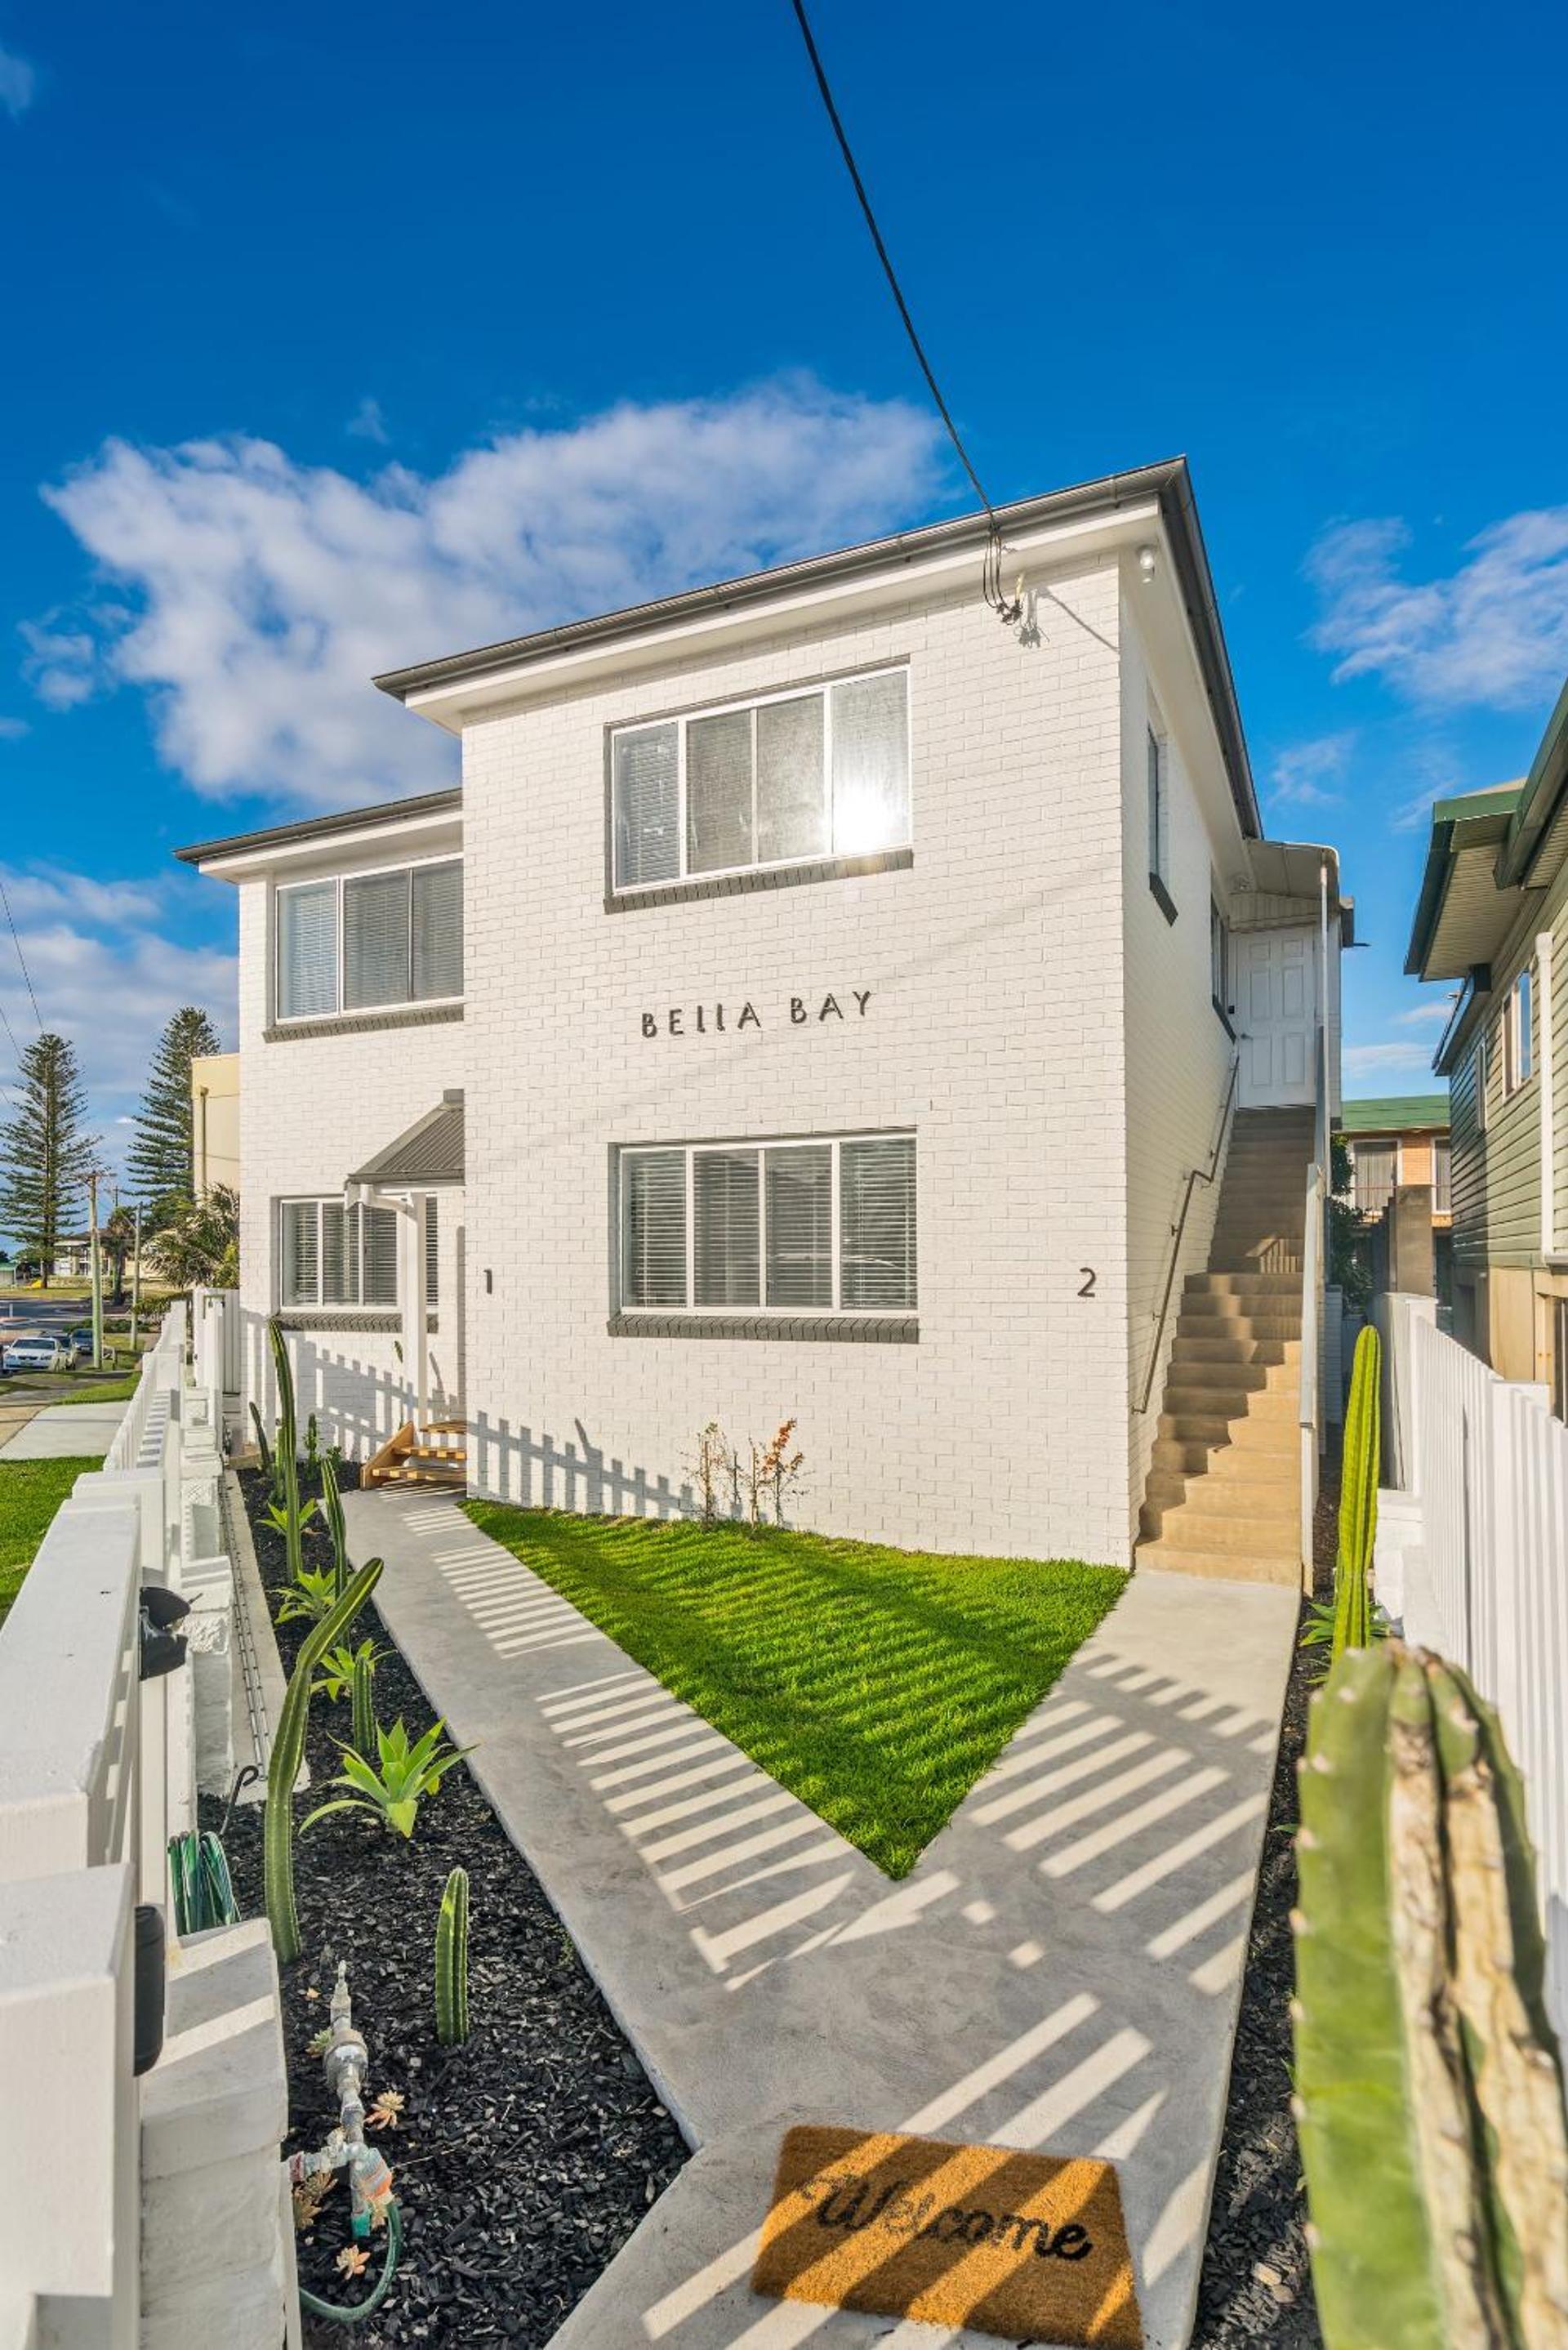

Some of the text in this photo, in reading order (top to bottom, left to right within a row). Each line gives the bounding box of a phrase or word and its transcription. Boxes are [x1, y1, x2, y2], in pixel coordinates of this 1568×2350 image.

[790, 990, 871, 1023] BAY
[1077, 1267, 1097, 1298] 2
[801, 2174, 1094, 2261] Welcome
